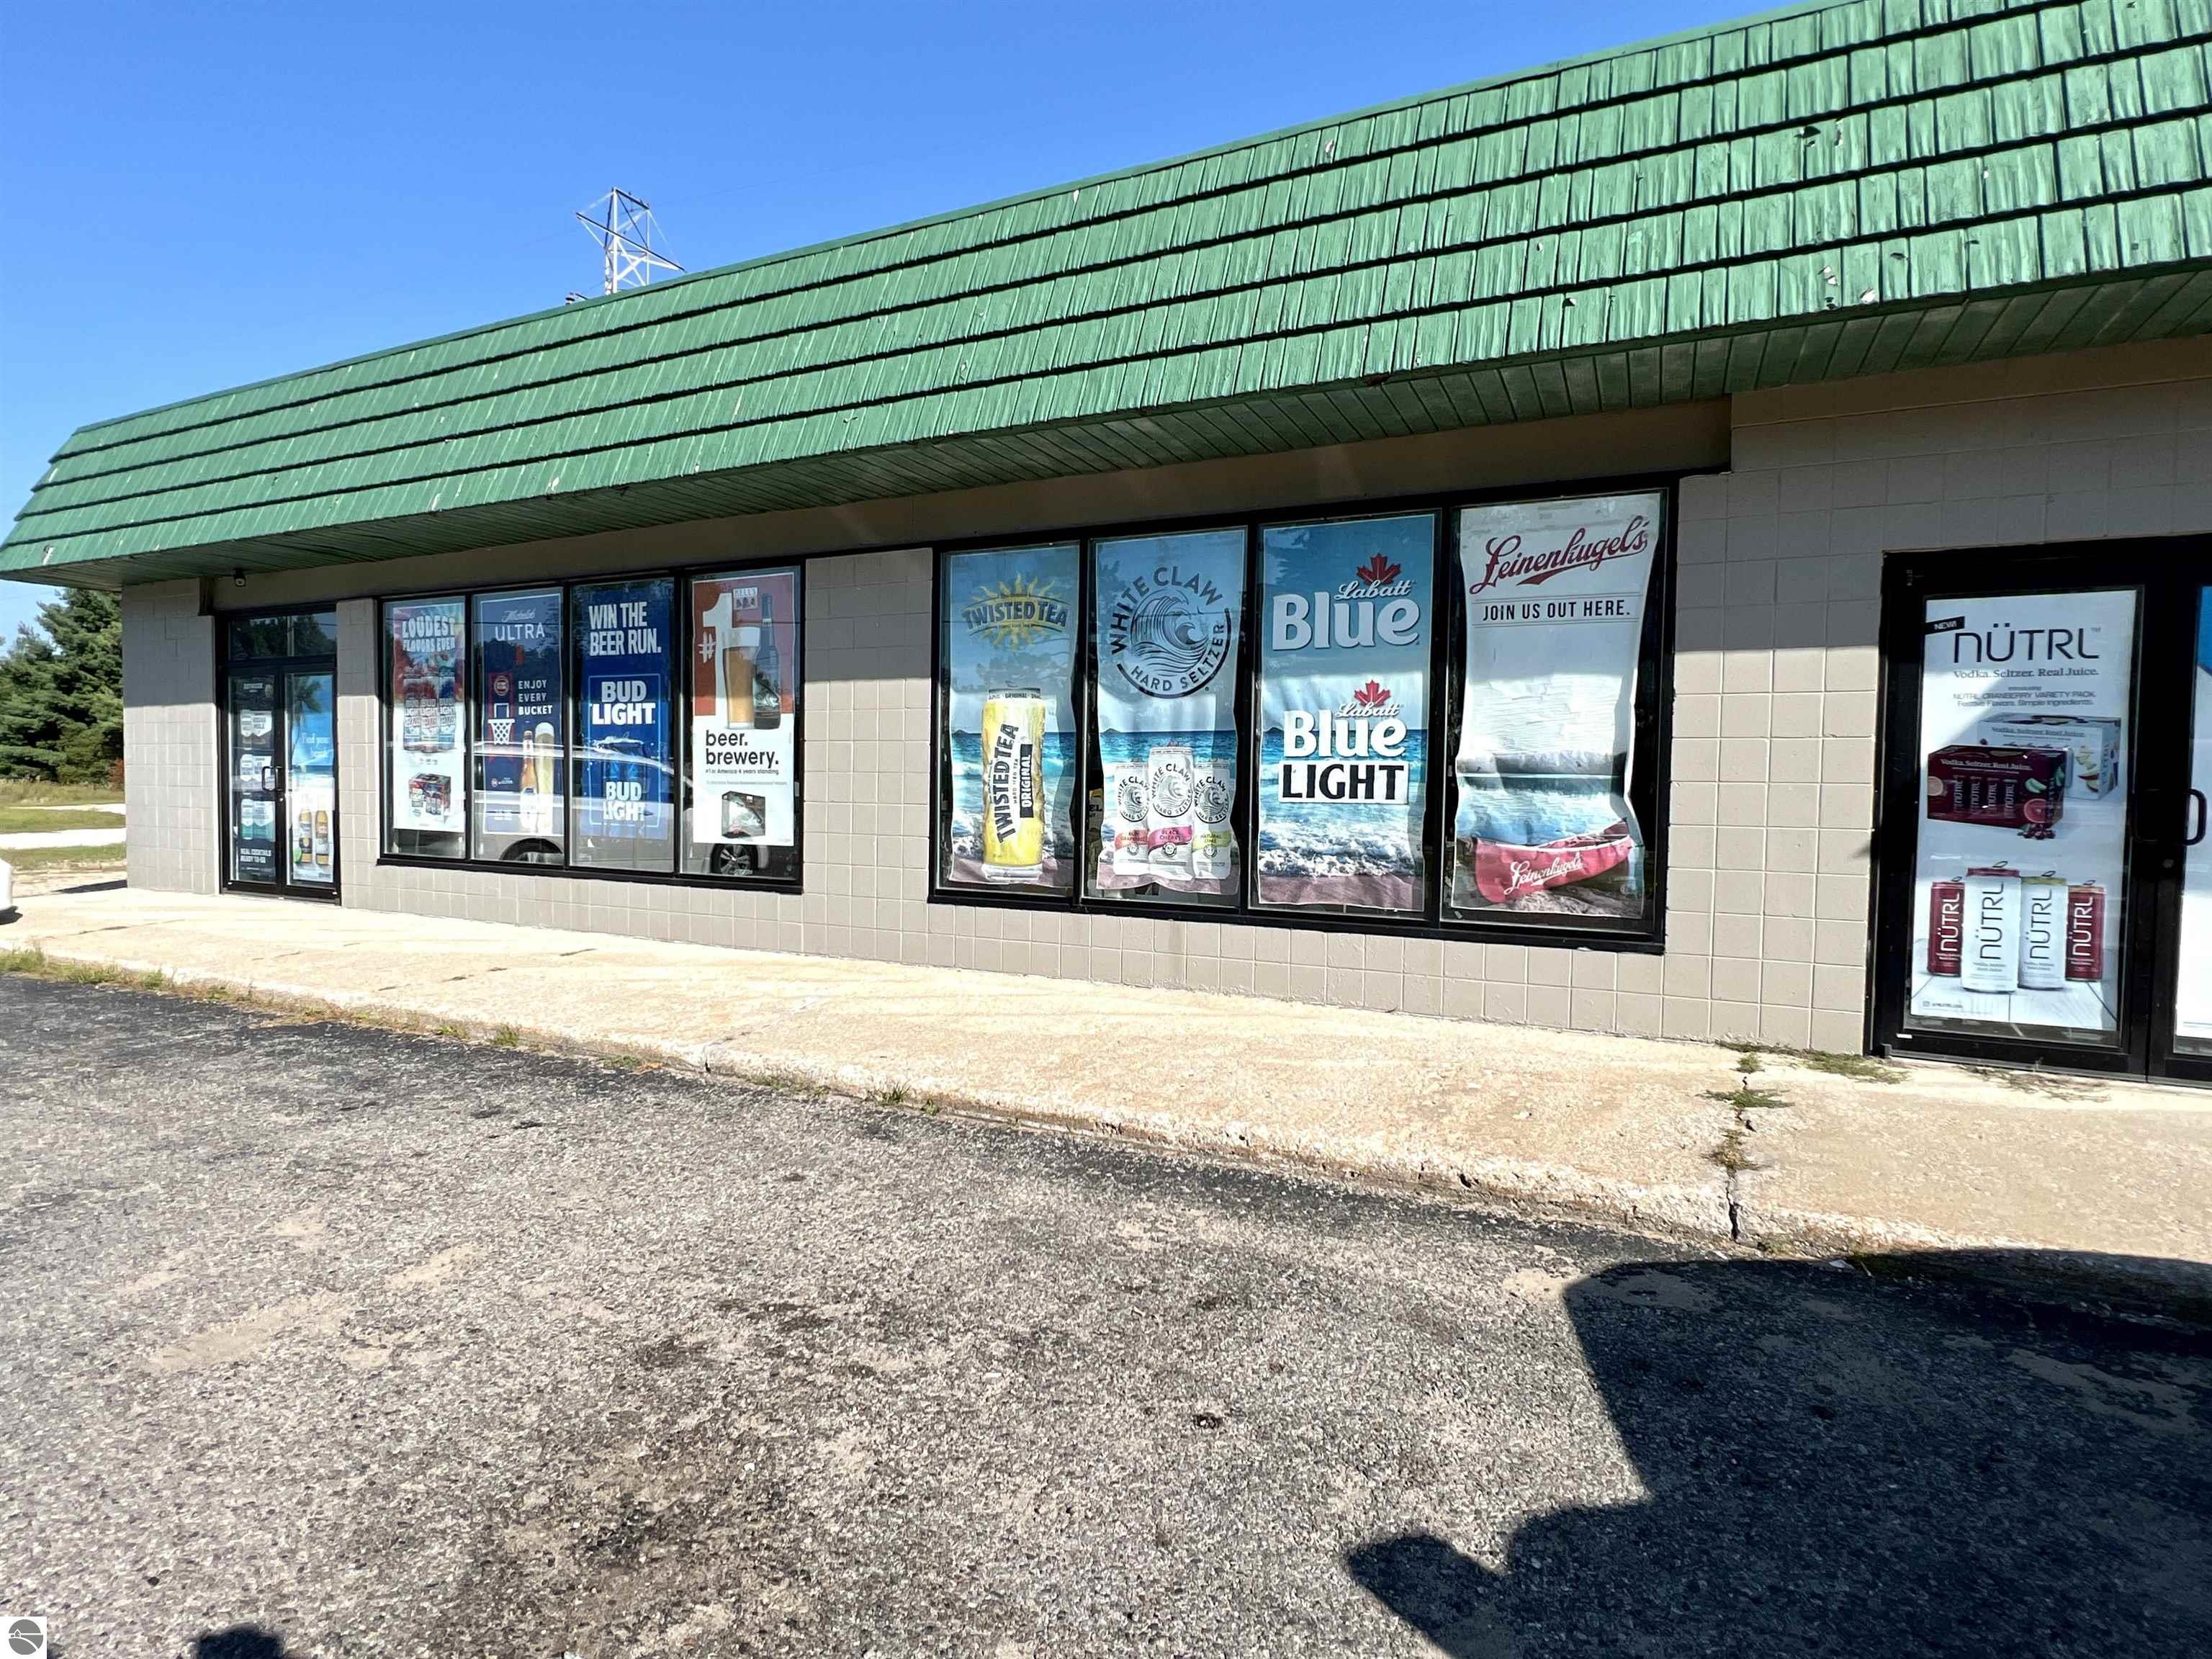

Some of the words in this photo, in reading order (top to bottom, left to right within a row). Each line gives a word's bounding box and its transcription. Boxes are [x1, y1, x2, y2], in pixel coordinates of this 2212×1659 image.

[1469, 516, 1650, 595] Leinenkugel's
[1334, 580, 1412, 600] Labatt
[588, 604, 617, 629] WIN
[620, 602, 647, 627] THE
[962, 601, 1035, 629] TWISTED
[1038, 601, 1069, 627] TEA
[1110, 576, 1150, 655] WHITE
[1154, 566, 1223, 606] CLAW
[1272, 591, 1420, 650] Blue
[1483, 605, 1514, 621] JOIN
[1523, 603, 1540, 619] US
[1547, 602, 1576, 617] OUT
[1584, 600, 1630, 616] HERE.
[403, 616, 455, 638] LOUDEST
[495, 622, 545, 641] ULTRA
[590, 630, 625, 656] BEER
[628, 628, 662, 654] RUN.
[1130, 665, 1172, 691] HARD
[1180, 624, 1224, 688] SELTZER
[1953, 670, 1990, 678] Vodka.
[1993, 669, 2035, 678] Seltzer.
[2038, 668, 2064, 677] Real
[2064, 667, 2100, 677] Juice.
[518, 680, 547, 690] ENJOY
[601, 680, 647, 702] BUD
[518, 693, 547, 702] EVERY
[518, 705, 553, 716] BUCKET
[592, 703, 656, 725] LIGHT
[1336, 702, 1401, 718] Labatt
[706, 729, 748, 746] beer.
[994, 724, 1019, 758] TEA
[1284, 709, 1407, 757] Blue
[706, 748, 778, 768] brewery.
[606, 781, 642, 801] BUD
[1022, 755, 1032, 808] ORIGINAL
[1128, 776, 1149, 791] CLAW
[1152, 767, 1164, 799] WHITE
[1166, 763, 1190, 781] CLAW
[1282, 764, 1404, 800] LIGHT
[603, 801, 645, 822] LIGHT
[993, 760, 1016, 843] TWISTED
